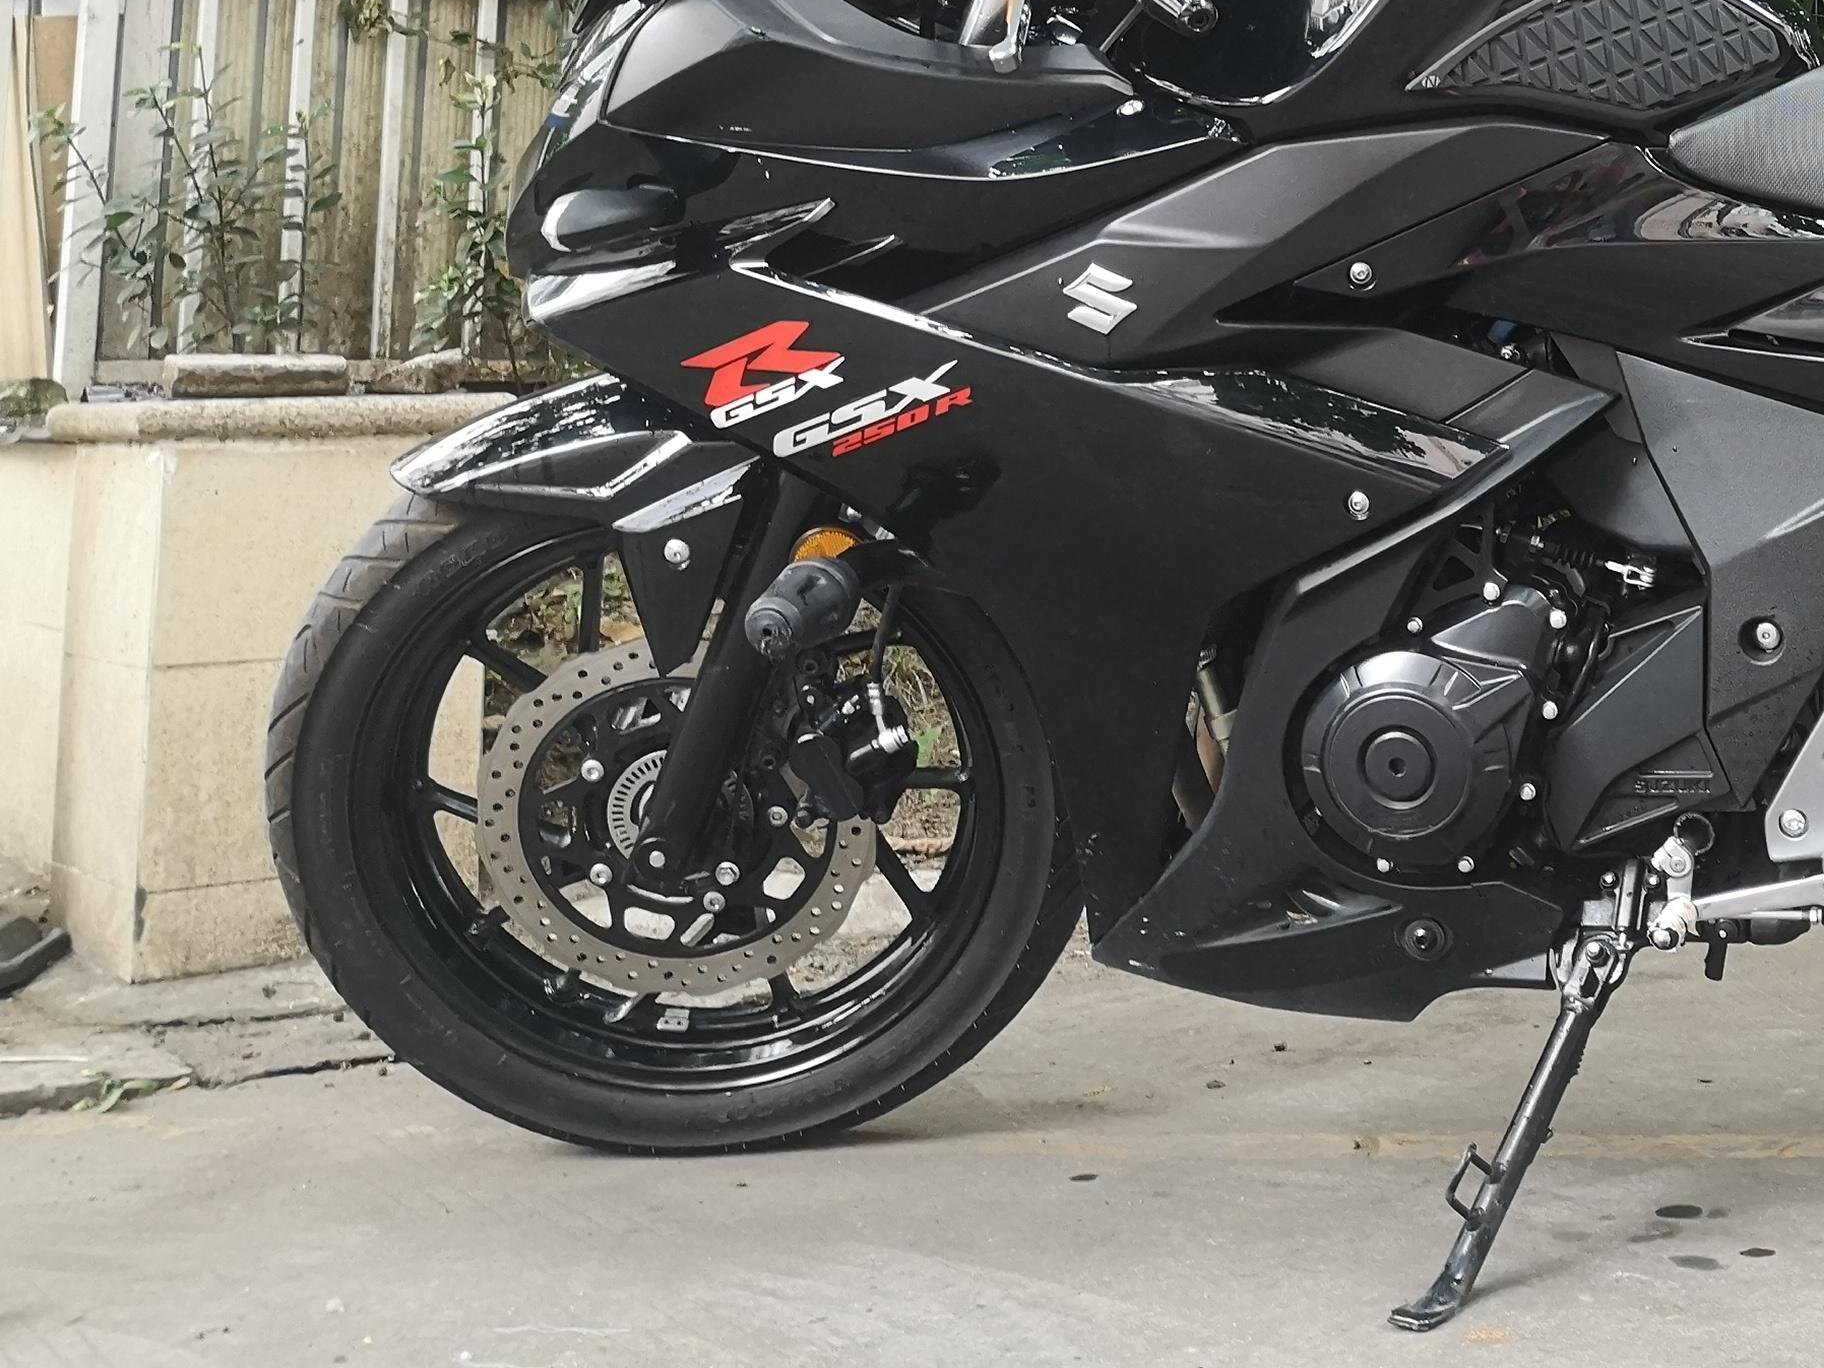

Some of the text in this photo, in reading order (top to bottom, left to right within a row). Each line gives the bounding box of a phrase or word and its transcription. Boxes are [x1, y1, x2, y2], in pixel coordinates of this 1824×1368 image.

[709, 356, 846, 430] GSX
[772, 359, 959, 459] GSX
[1635, 779, 1711, 793] SUZUKI
